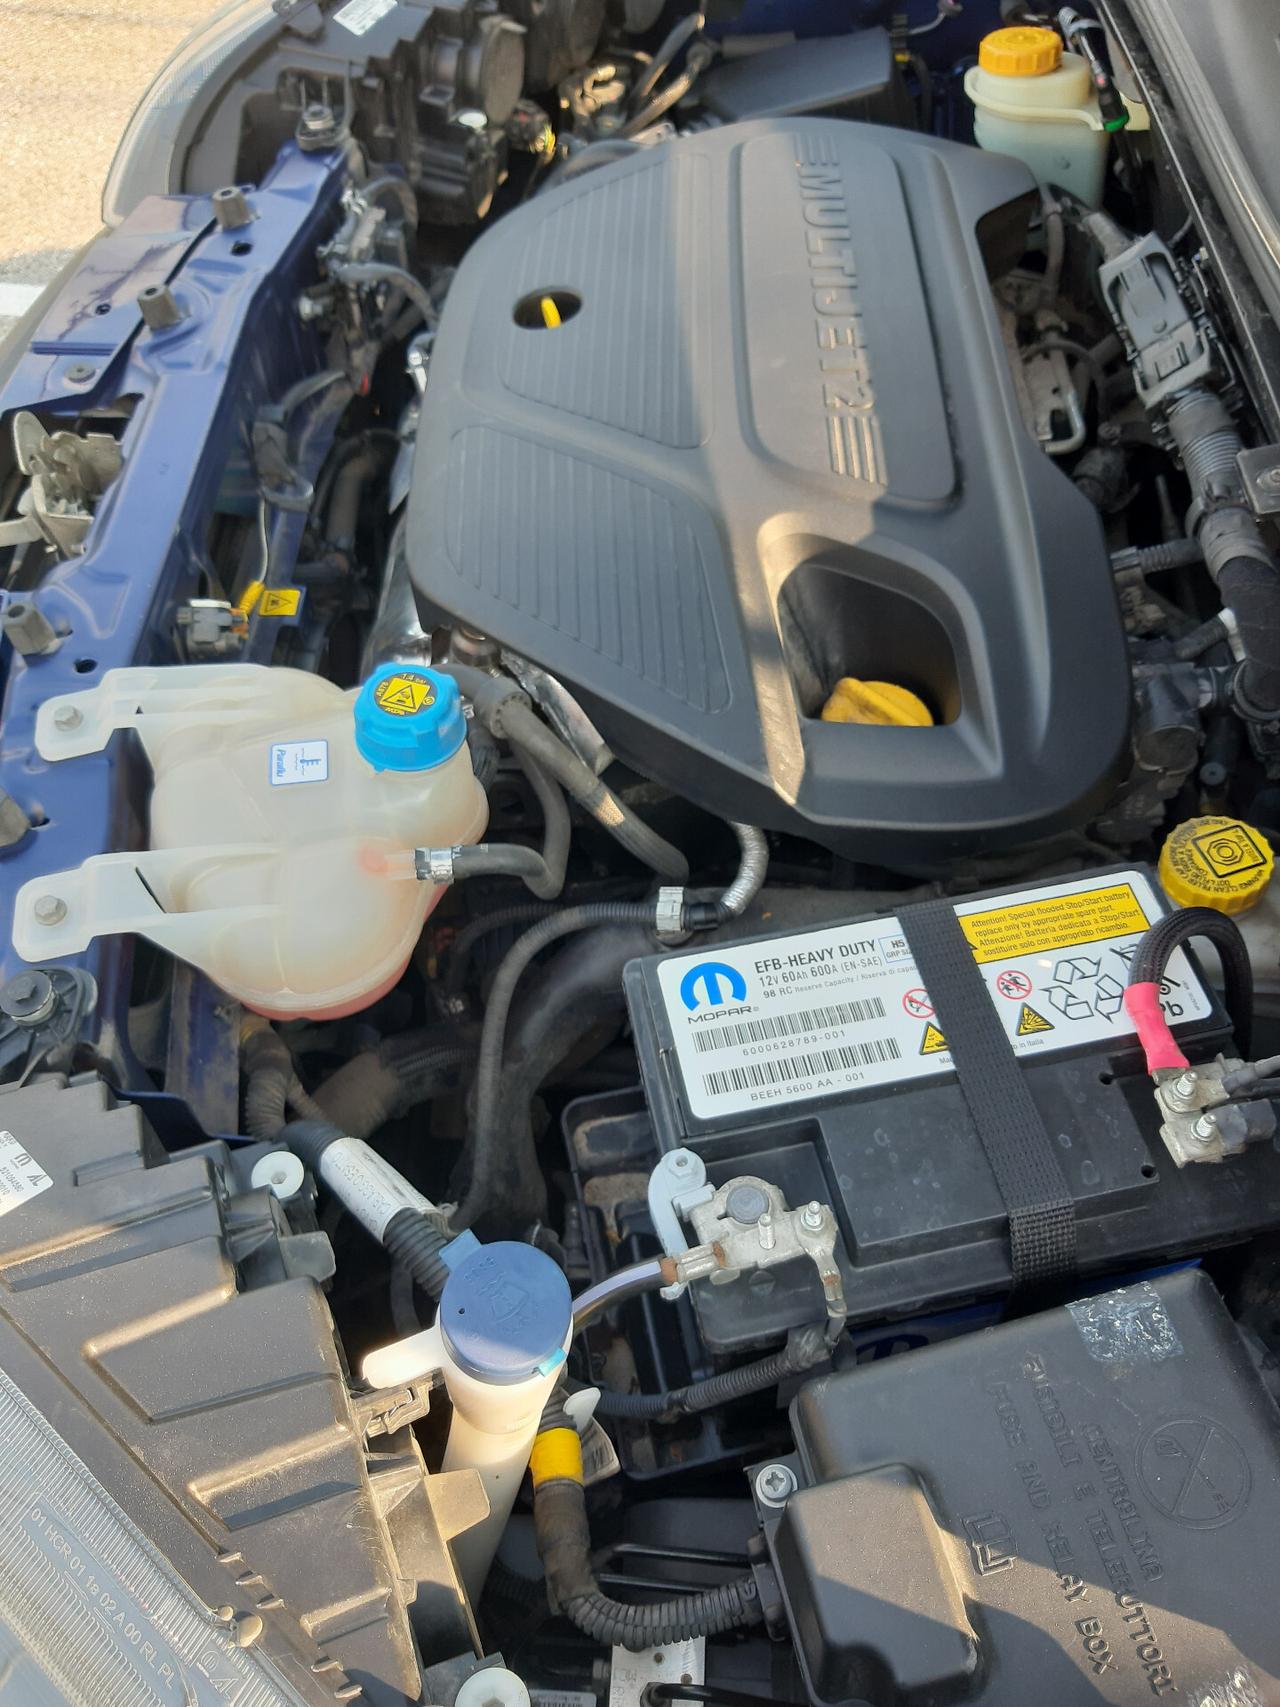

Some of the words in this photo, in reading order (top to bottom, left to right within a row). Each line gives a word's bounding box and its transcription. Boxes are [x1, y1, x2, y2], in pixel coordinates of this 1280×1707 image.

[971, 914, 1006, 928] Attention!
[1008, 909, 1036, 921] Special
[1037, 904, 1064, 914] flooded
[1065, 896, 1102, 910] Stop/Start
[1103, 891, 1130, 902] battery
[975, 926, 1004, 938] replace
[1004, 923, 1020, 932] only
[1021, 921, 1031, 929] by
[1032, 912, 1075, 926] appropriate
[1075, 908, 1097, 918] spare
[979, 932, 1024, 947] Attenzione!
[1024, 926, 1057, 938] Batteria
[1058, 919, 1092, 931] dedicata
[1099, 908, 1140, 923] Stop/Start
[754, 947, 834, 974] EFB-HEAVY
[838, 938, 876, 958] DUTY
[891, 939, 905, 948] H5
[983, 943, 1018, 956] sostituire
[1019, 940, 1036, 949] solo
[1036, 937, 1051, 946] con
[1052, 930, 1094, 944] appropriato
[781, 970, 809, 983] 60Ah
[810, 964, 838, 977] 600A
[840, 956, 883, 974] (EN-SAE)
[763, 990, 776, 998] 98
[779, 986, 793, 997] RC
[688, 1005, 752, 1024] MOPAR
[742, 1030, 846, 1056] 6000628789-001
[786, 1082, 814, 1095] 5600
[817, 1078, 834, 1088] AA
[845, 1072, 866, 1083] 001
[31, 1508, 47, 1527] 01
[44, 1524, 72, 1560] HCR
[70, 1556, 87, 1577] 01
[100, 1592, 117, 1616] 02
[113, 1611, 126, 1627] A
[124, 1622, 142, 1645] 00
[139, 1640, 158, 1668] RL
[157, 1662, 175, 1690] PL
[1075, 1616, 1118, 1675] BOX
